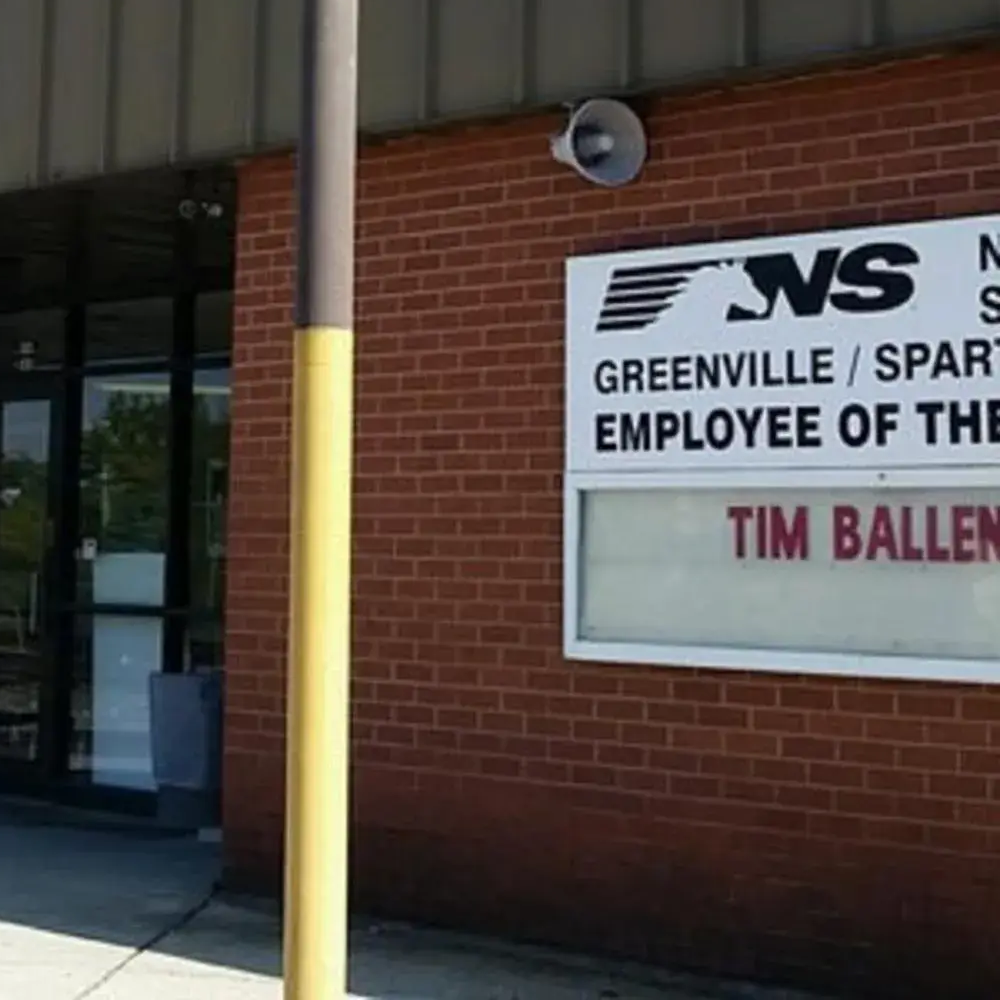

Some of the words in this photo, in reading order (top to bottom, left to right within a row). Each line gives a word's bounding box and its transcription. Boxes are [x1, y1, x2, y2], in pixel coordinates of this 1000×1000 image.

[594, 348, 834, 394] GREENVILLE
[847, 344, 861, 386] /
[875, 337, 1000, 382] SPAR
[595, 406, 822, 452] EMPLOYEE
[838, 403, 900, 448] OF
[915, 399, 1000, 445] THE
[727, 506, 810, 560] TIM
[832, 505, 1000, 563] BALLEN
